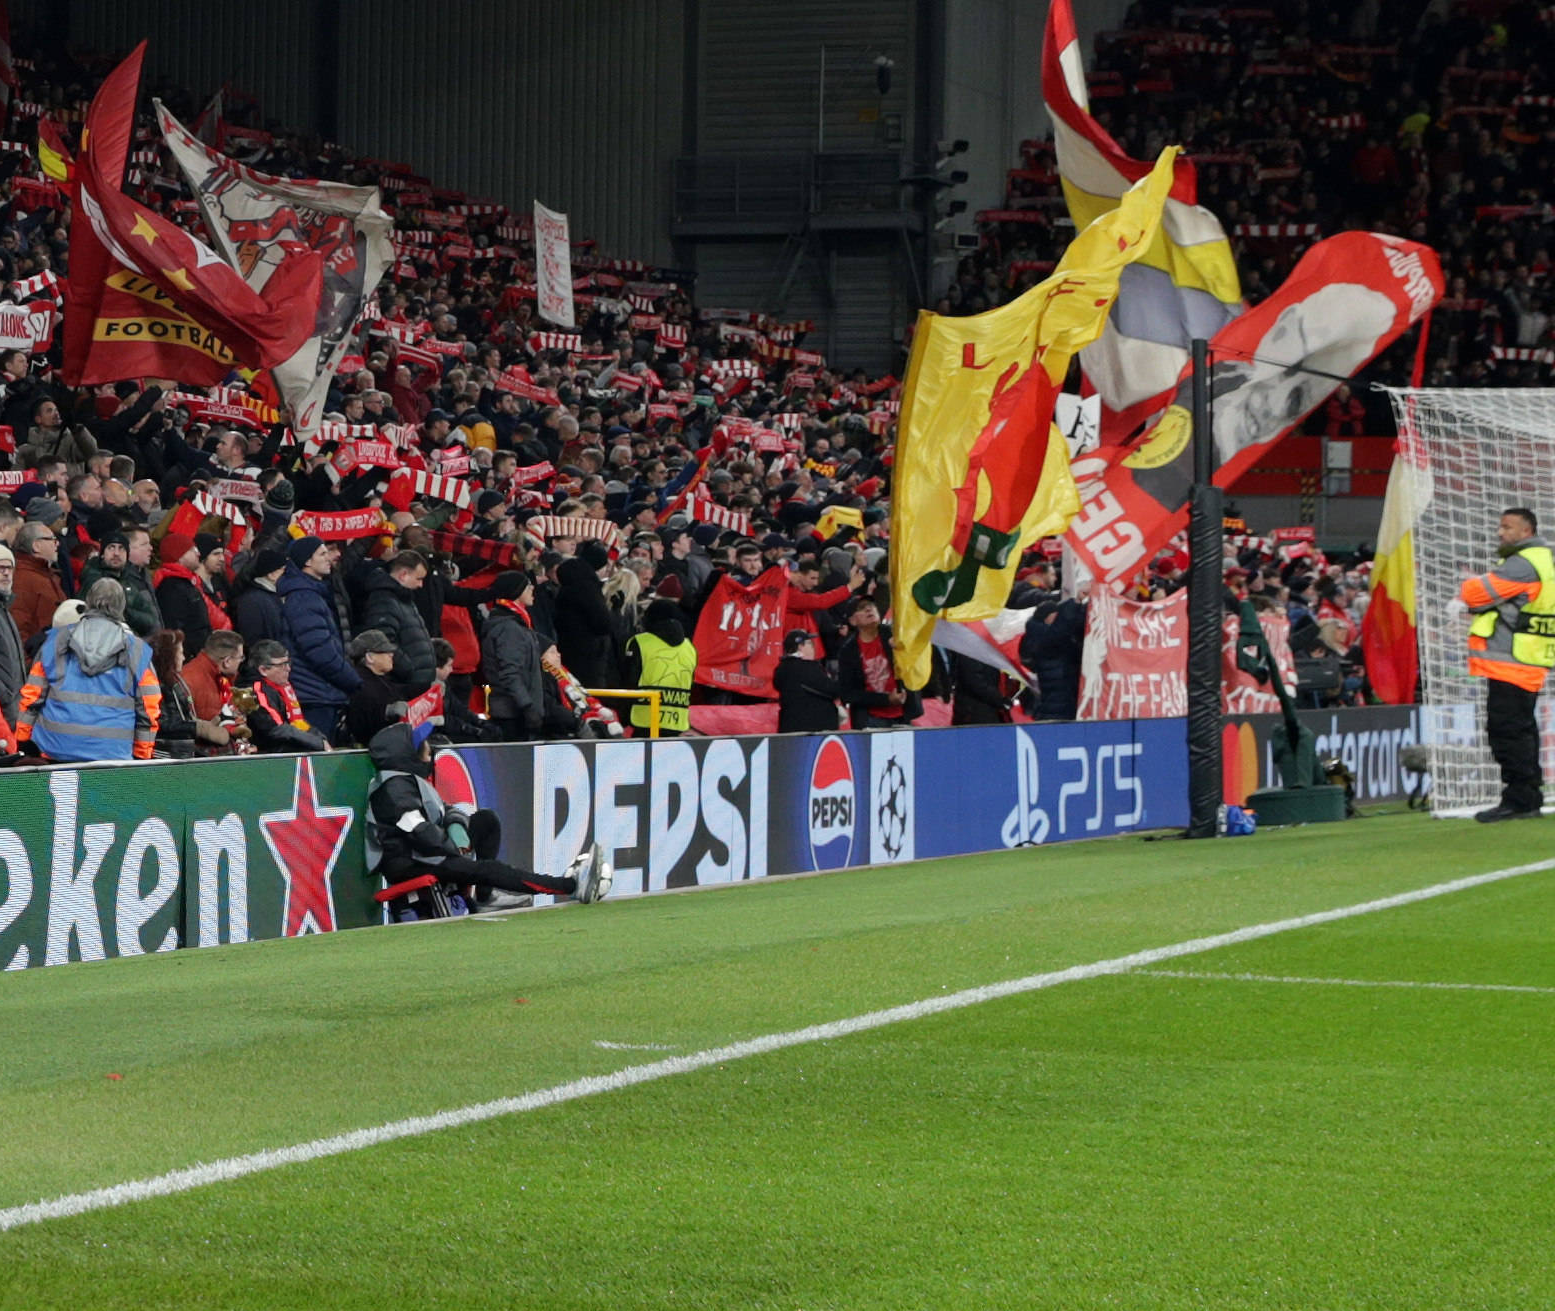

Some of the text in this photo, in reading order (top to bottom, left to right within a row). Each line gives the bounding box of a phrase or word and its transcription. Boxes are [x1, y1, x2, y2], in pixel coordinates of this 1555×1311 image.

[533, 737, 770, 907] PEPSI
[811, 795, 853, 830] PEPSI
[1058, 743, 1143, 835] PS5
